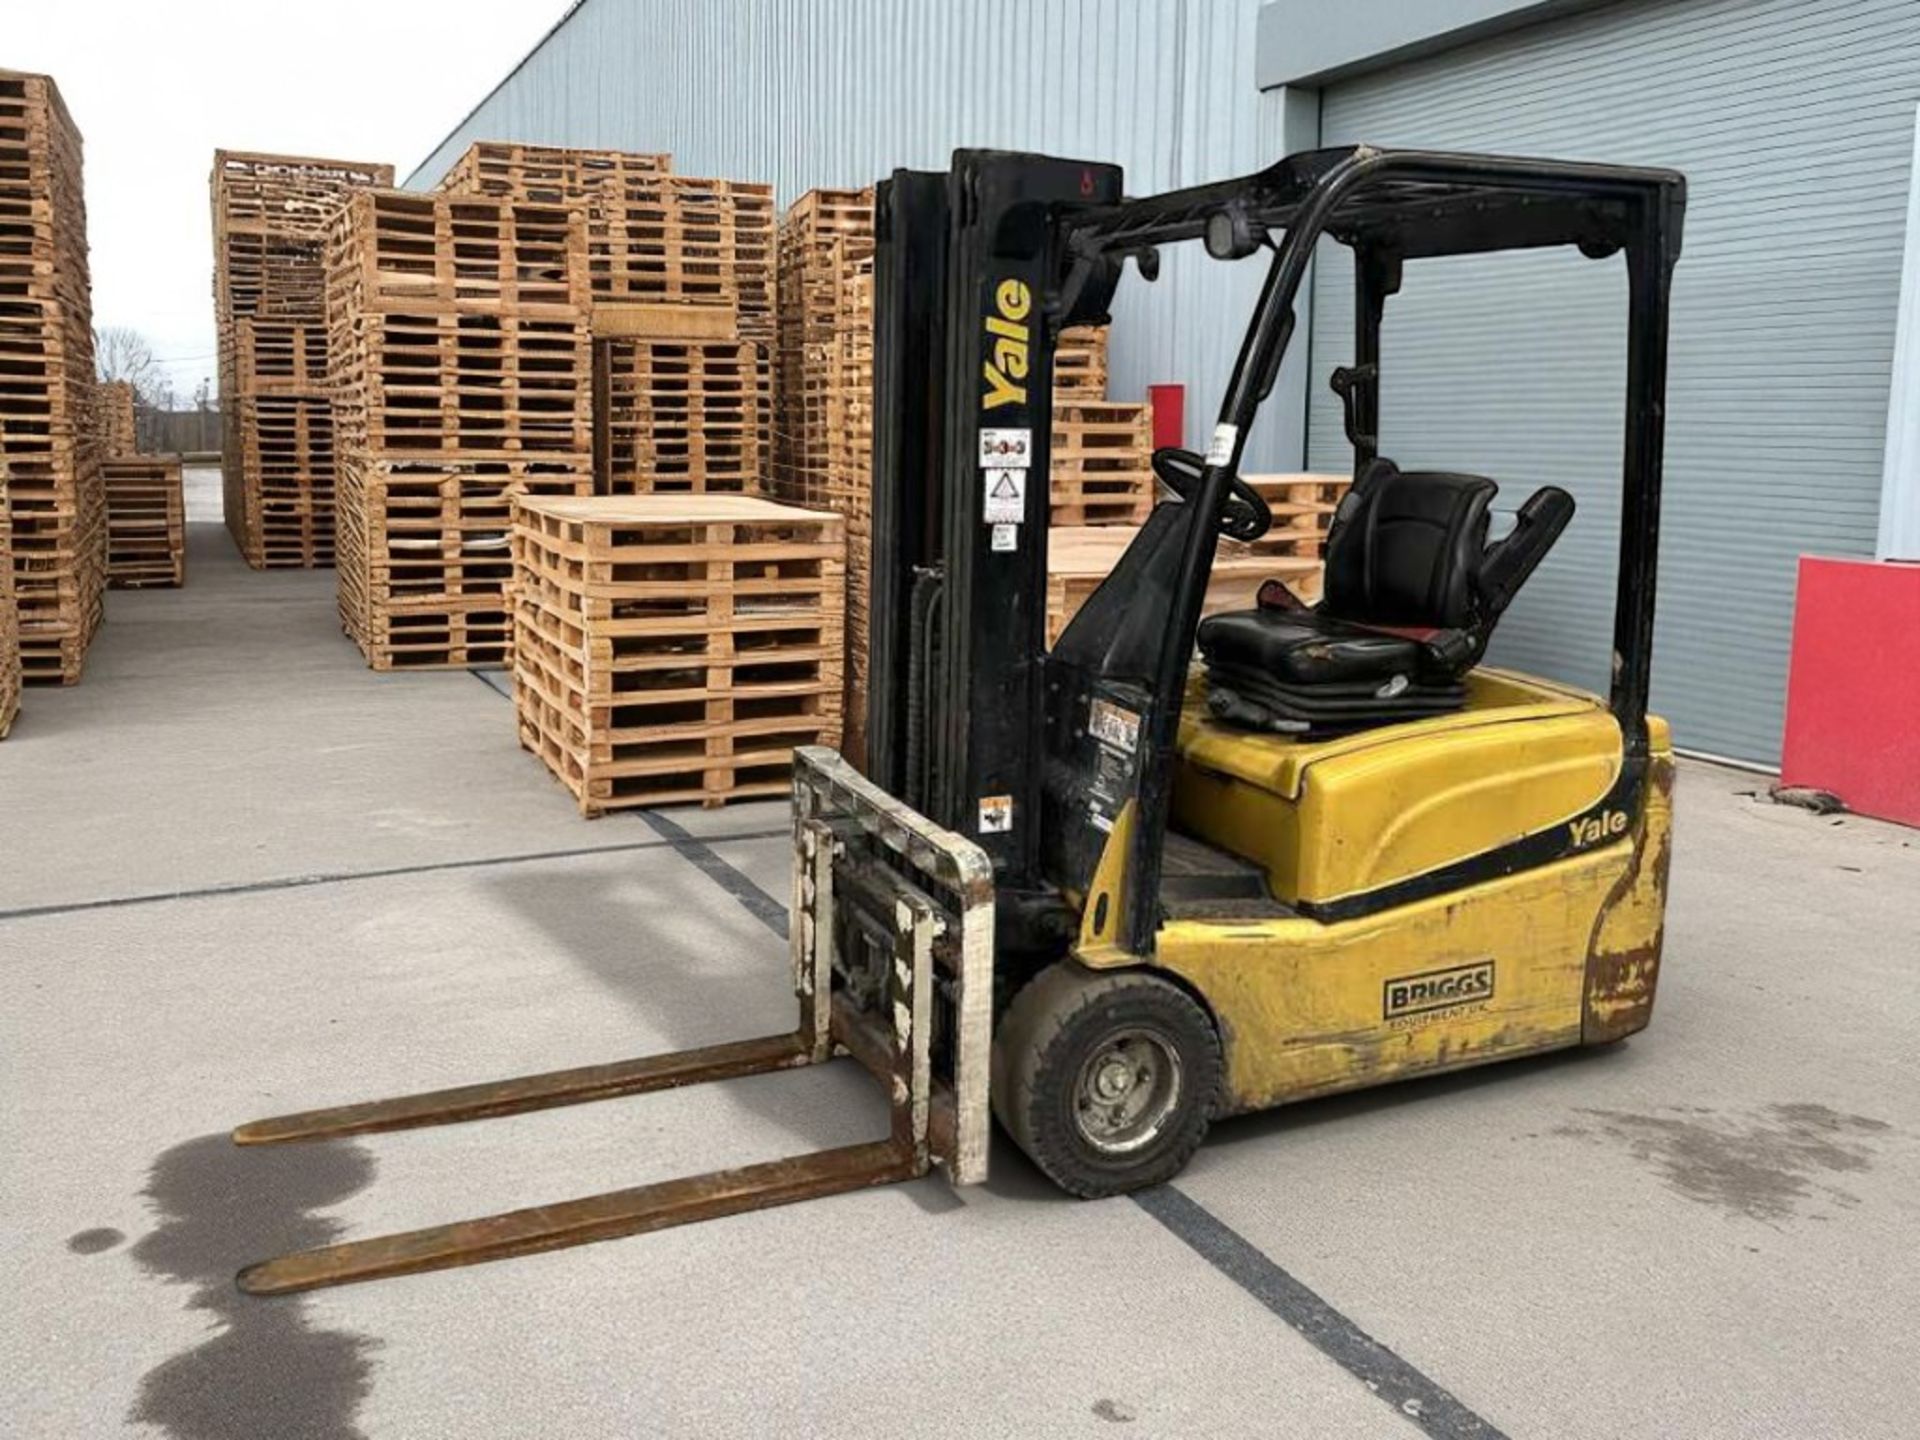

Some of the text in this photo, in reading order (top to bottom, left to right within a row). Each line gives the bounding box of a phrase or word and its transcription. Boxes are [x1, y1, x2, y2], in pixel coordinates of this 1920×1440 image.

[983, 279, 1031, 409] Yale
[1569, 810, 1627, 847] Yale
[1391, 969, 1488, 1009] BRIGGS
